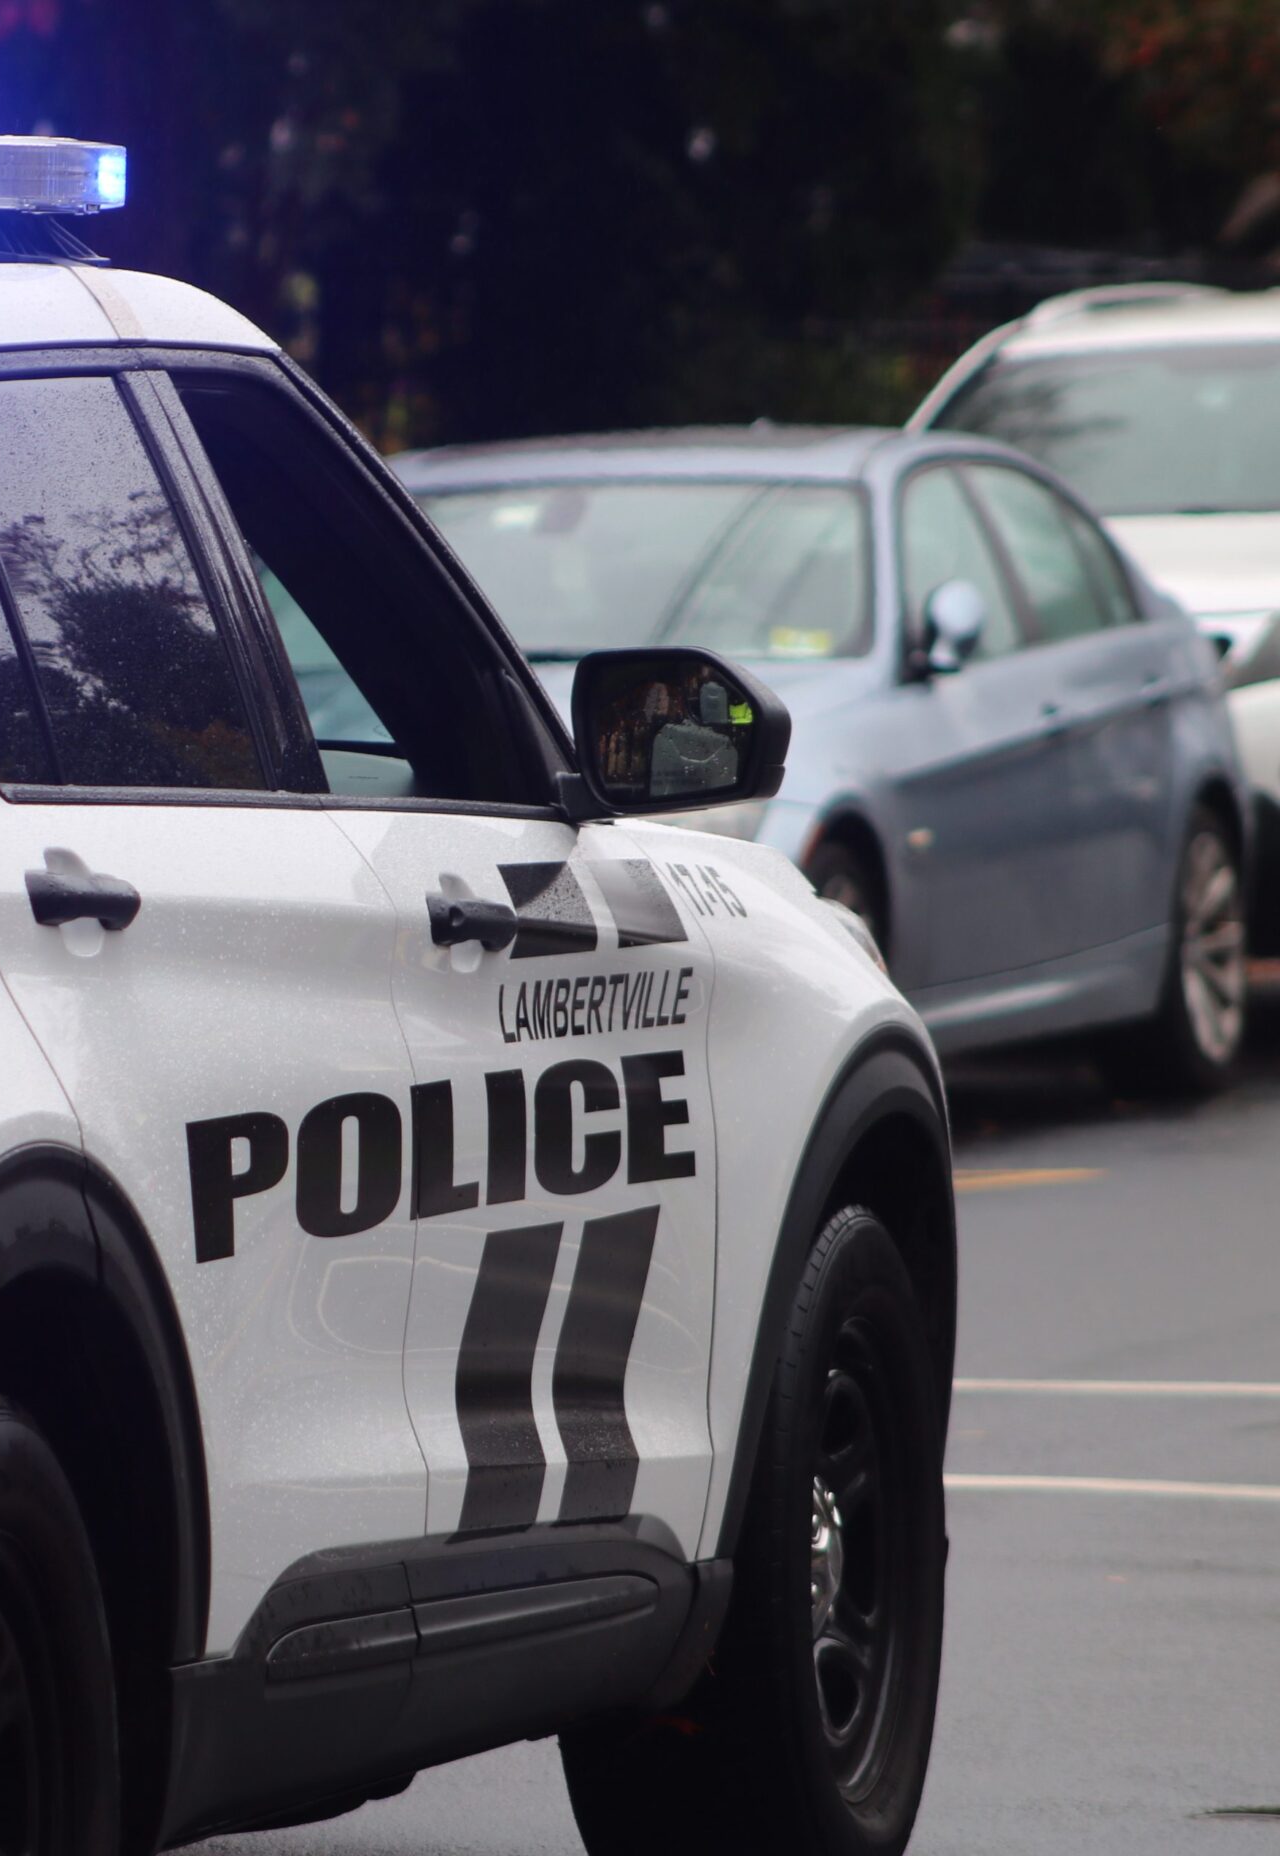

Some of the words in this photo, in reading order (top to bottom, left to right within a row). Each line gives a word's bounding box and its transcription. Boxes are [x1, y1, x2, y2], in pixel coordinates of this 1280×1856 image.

[665, 862, 747, 918] 17-15
[498, 967, 693, 1043] LAMBERTVILLE
[185, 1050, 696, 1264] POLICE
